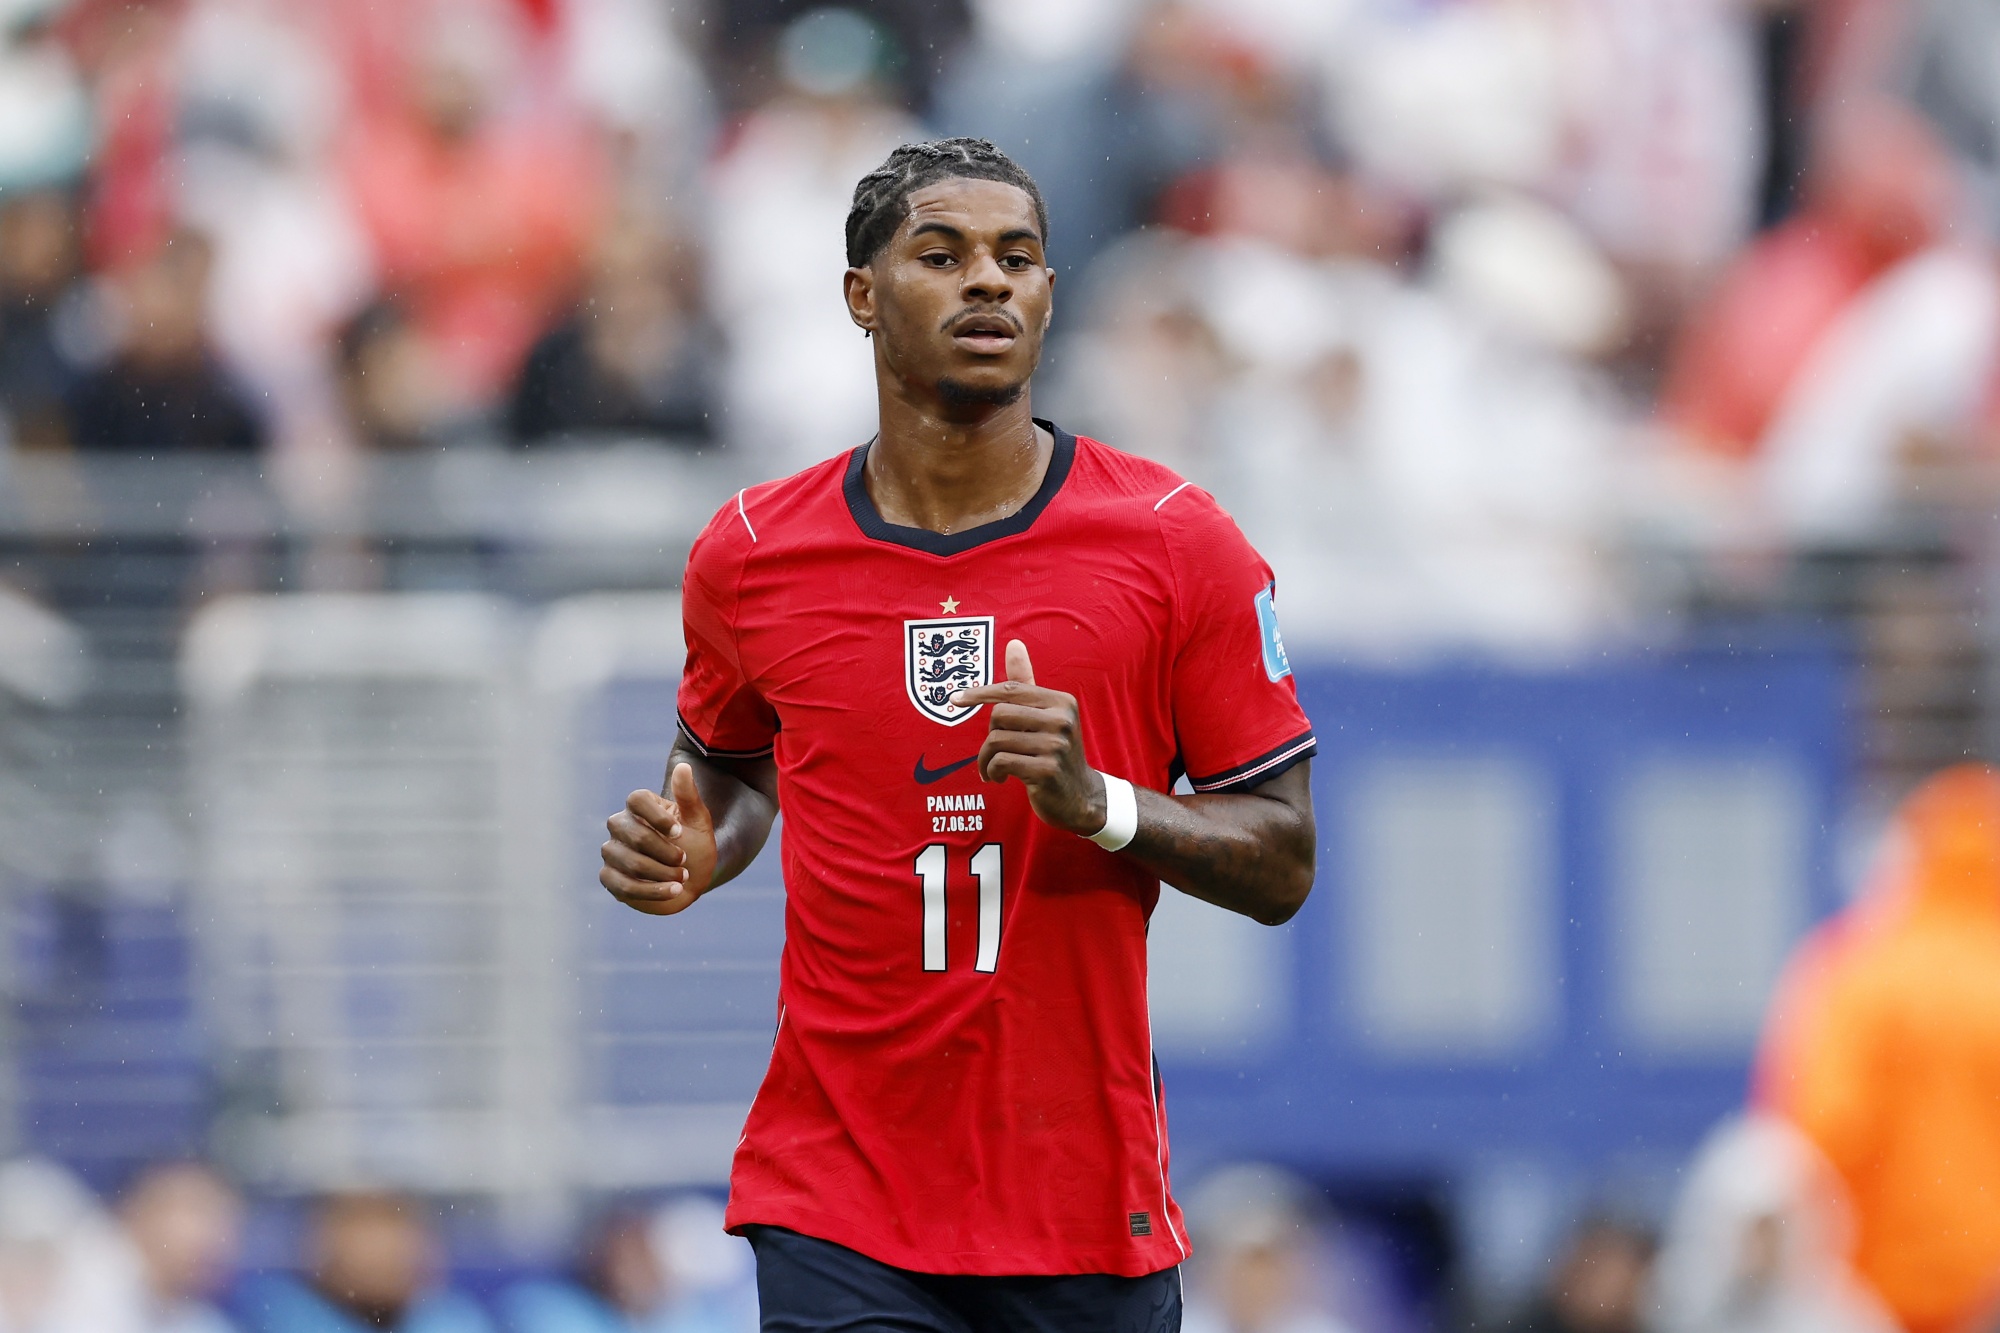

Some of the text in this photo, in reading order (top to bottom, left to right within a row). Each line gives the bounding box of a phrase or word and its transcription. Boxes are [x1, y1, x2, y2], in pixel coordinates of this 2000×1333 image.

[926, 794, 986, 812] PANAMA
[932, 815, 983, 832] 27.06.26
[914, 842, 1003, 974] 11
